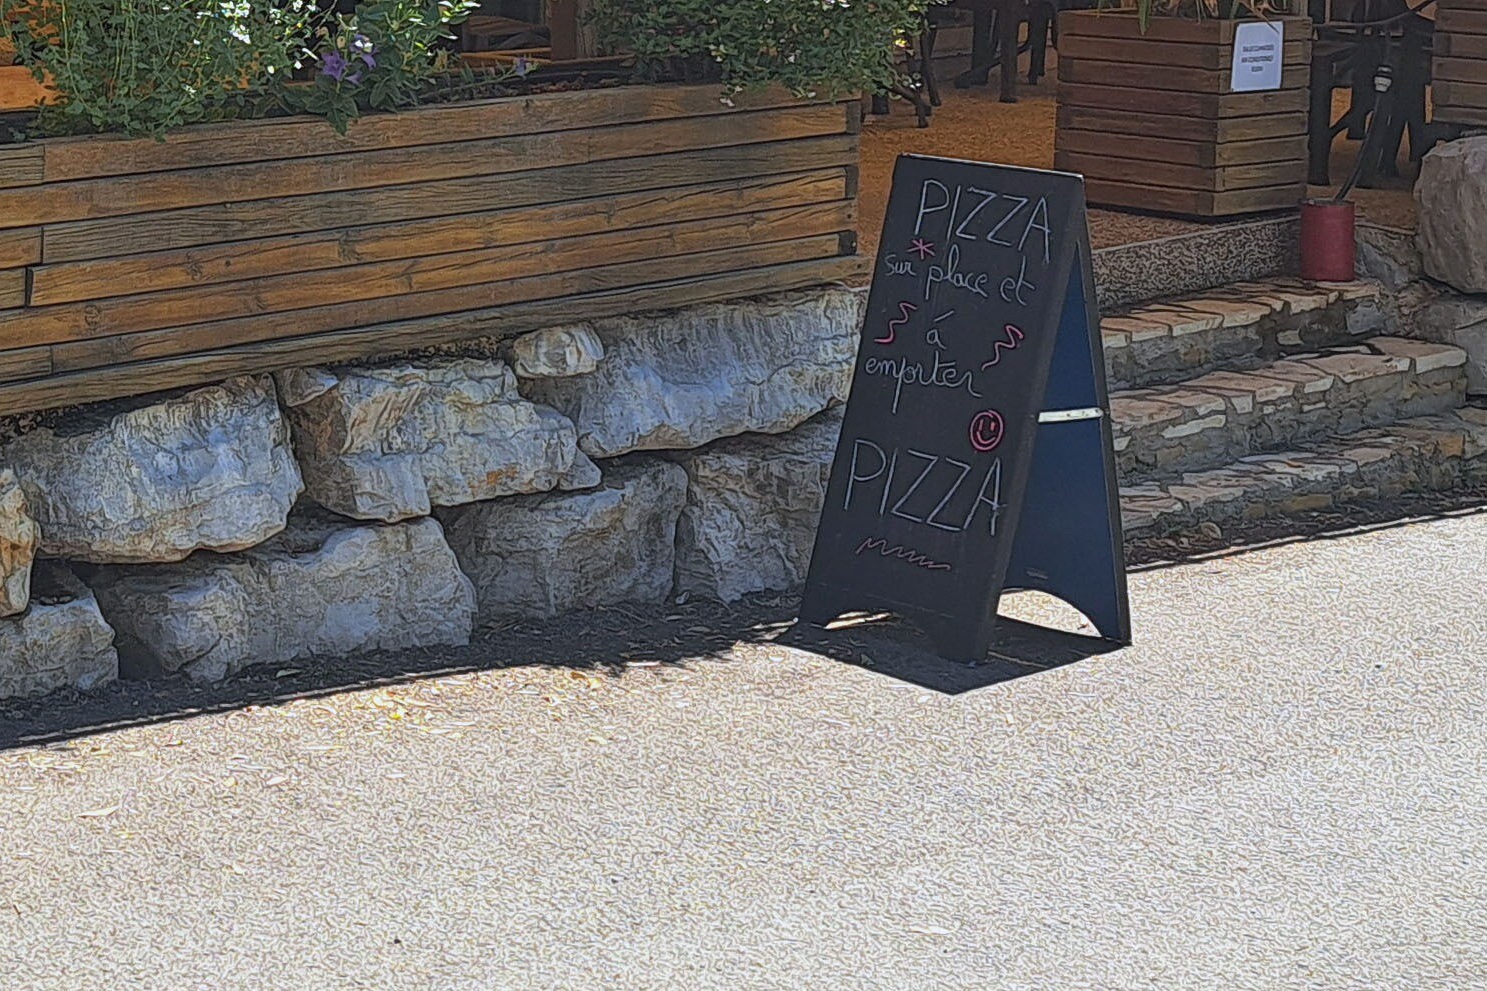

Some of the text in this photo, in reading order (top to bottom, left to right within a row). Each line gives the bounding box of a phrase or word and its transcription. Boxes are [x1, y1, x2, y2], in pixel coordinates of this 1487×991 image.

[914, 179, 1051, 264] PIZZA
[925, 244, 988, 300] place
[1000, 255, 1035, 306] et
[865, 350, 983, 414] emporter
[844, 439, 1007, 536] PIZZA
